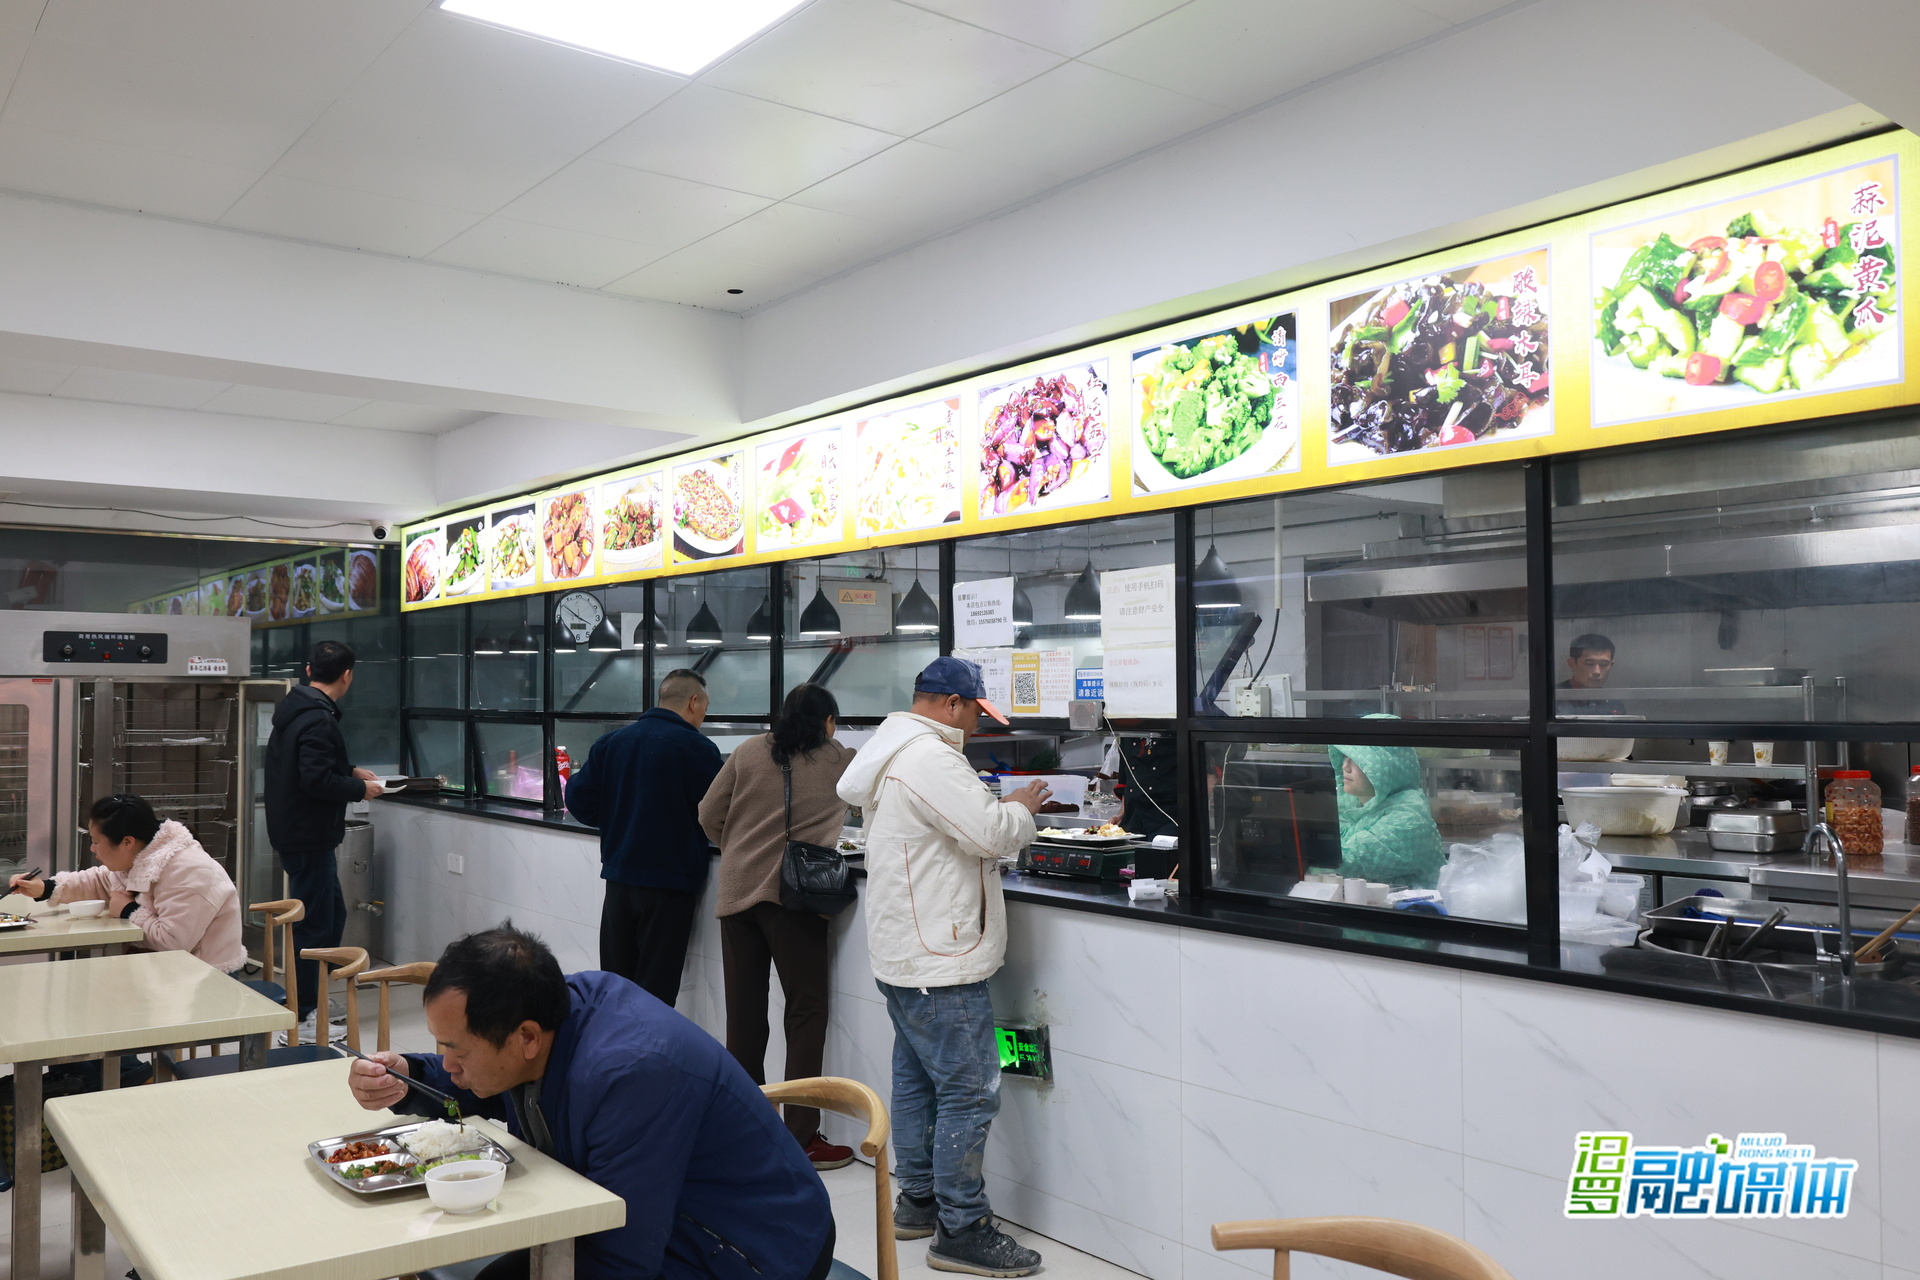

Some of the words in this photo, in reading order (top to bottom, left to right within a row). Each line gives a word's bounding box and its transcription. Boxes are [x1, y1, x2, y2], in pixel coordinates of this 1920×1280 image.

[1851, 182, 1887, 327] 蒜泥黄瓜
[1513, 266, 1540, 388] 酸辣木耳
[1086, 374, 1102, 463] 红烧茄子
[1272, 326, 1288, 430] 清炒西兰花
[1119, 603, 1165, 616] 请注意财产安全
[1124, 580, 1164, 593] 使用手机扫码
